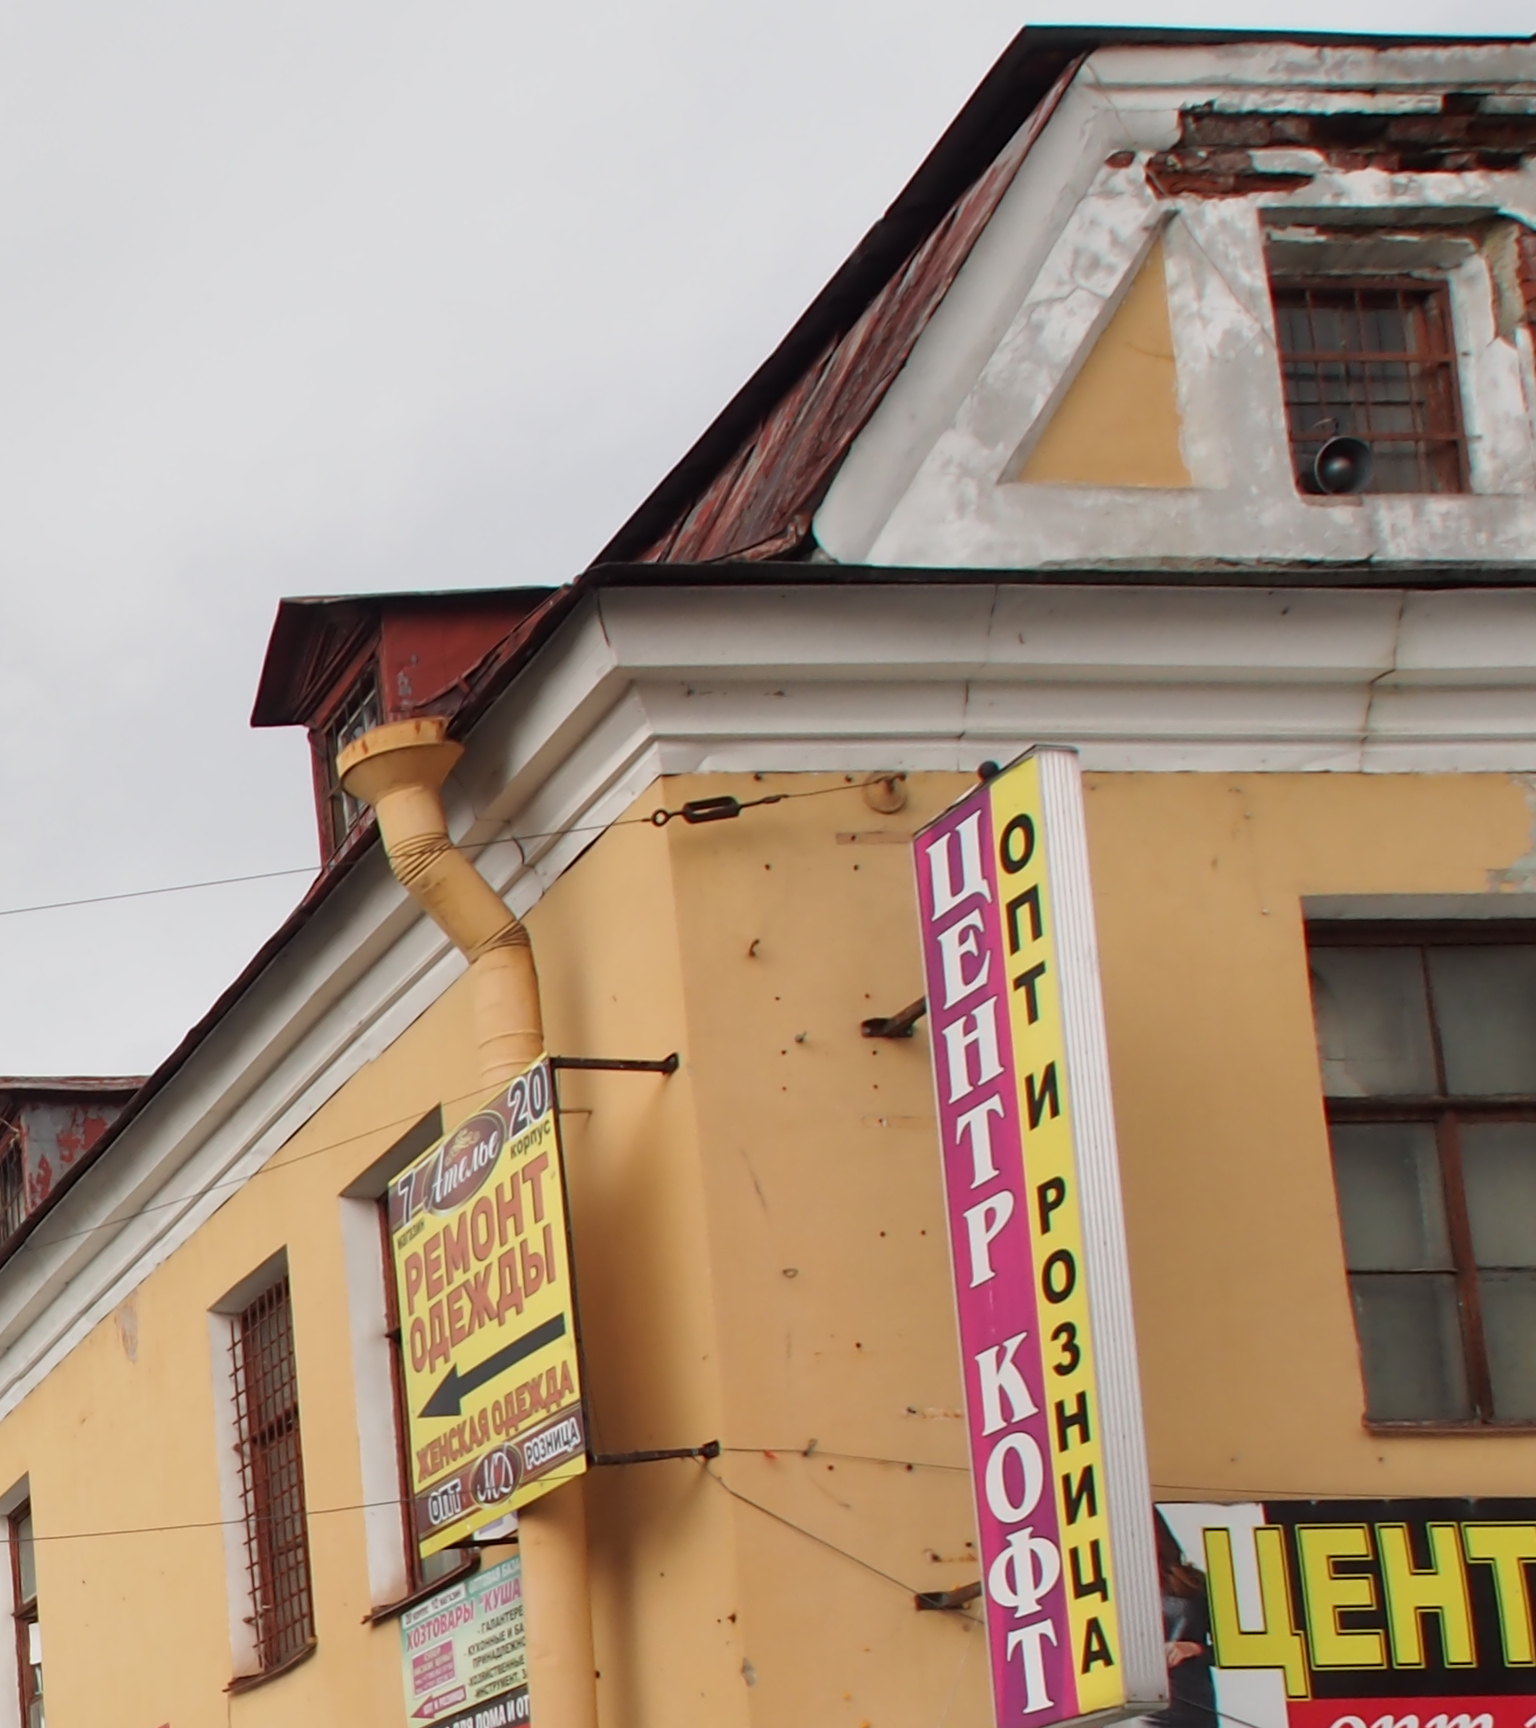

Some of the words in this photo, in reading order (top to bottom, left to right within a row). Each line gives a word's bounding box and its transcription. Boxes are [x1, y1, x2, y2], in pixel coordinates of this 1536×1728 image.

[997, 812, 1047, 1028] ОПТ
[506, 1060, 551, 1142] 20
[1021, 1058, 1063, 1136] И
[428, 1128, 502, 1205] Ателье
[509, 1120, 552, 1161] корпус
[396, 1171, 418, 1227] 7
[403, 1151, 551, 1317] РЕМОНТ
[408, 1222, 557, 1375] ОДЕЖДЫ
[924, 806, 1017, 1292] ЦЕНТР
[973, 1330, 1062, 1716] КОФТ
[416, 1408, 491, 1484] ЖЕНСКАЯ
[491, 1360, 576, 1439] ОДЕЖДА
[524, 1416, 582, 1469] РОЗНИЦА
[1034, 1174, 1115, 1678] РОЗНИЦА
[429, 1478, 463, 1526] ОПТ
[406, 1599, 476, 1653] ХОЗТОВАРЫ
[507, 1702, 516, 1722] И
